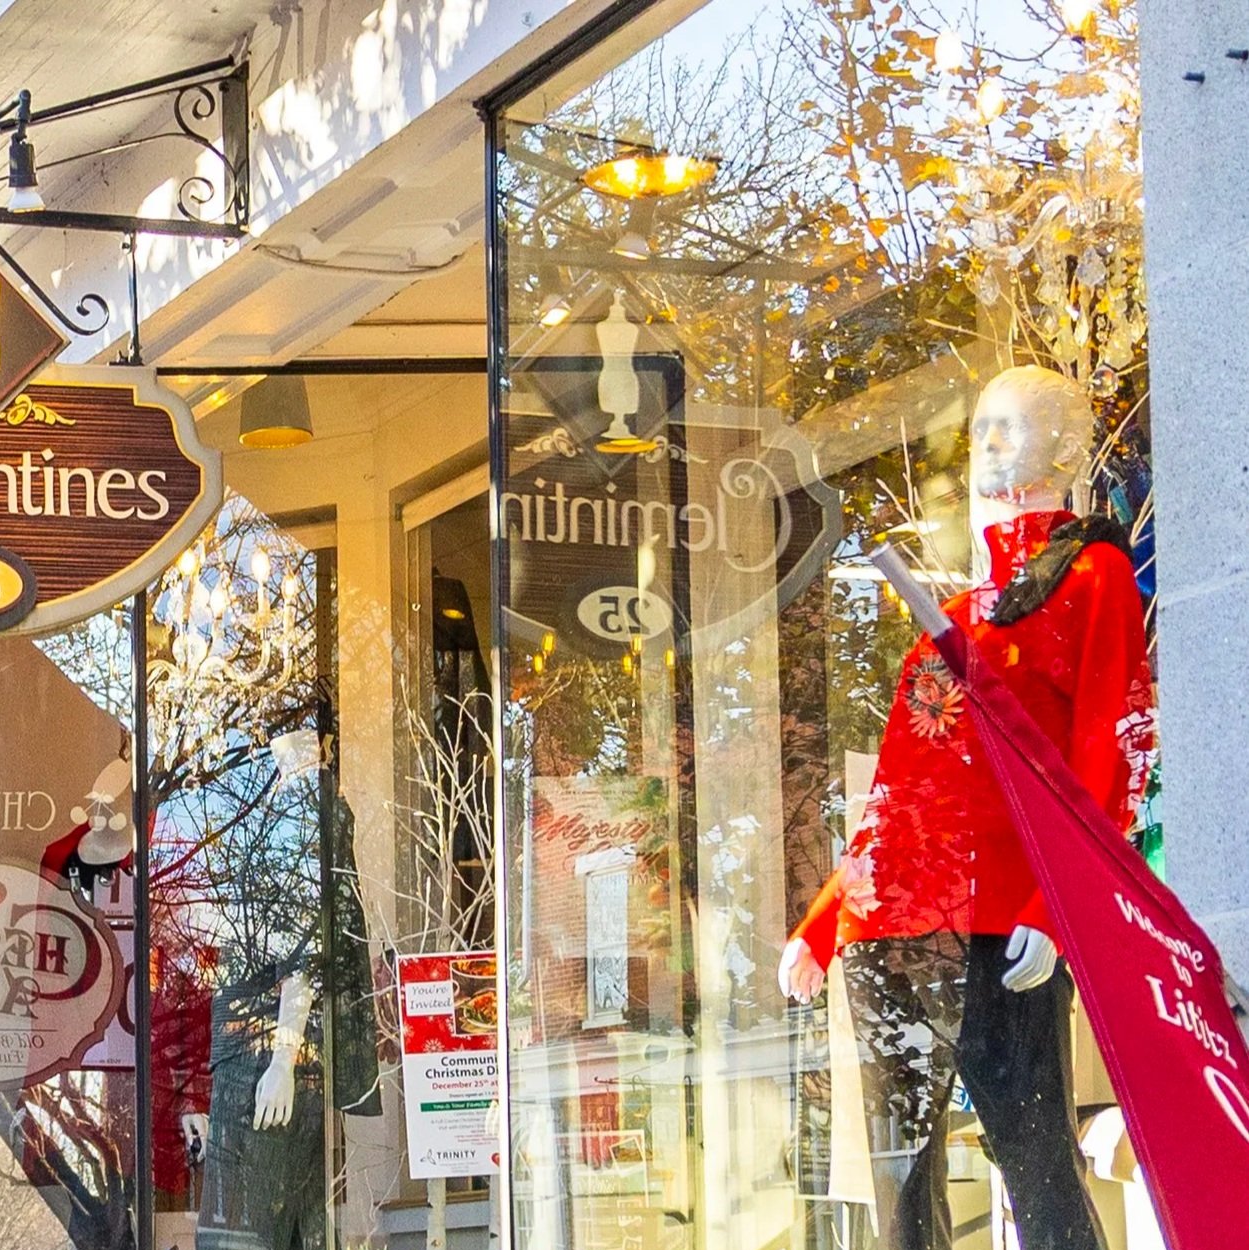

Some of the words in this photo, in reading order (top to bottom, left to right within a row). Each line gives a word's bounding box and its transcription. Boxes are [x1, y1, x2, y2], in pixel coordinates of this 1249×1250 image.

[412, 984, 448, 996] You're
[410, 998, 453, 1010] Invited
[425, 1067, 484, 1080] Christmas
[432, 1081, 472, 1091] December
[436, 1149, 476, 1160] TRINITY
